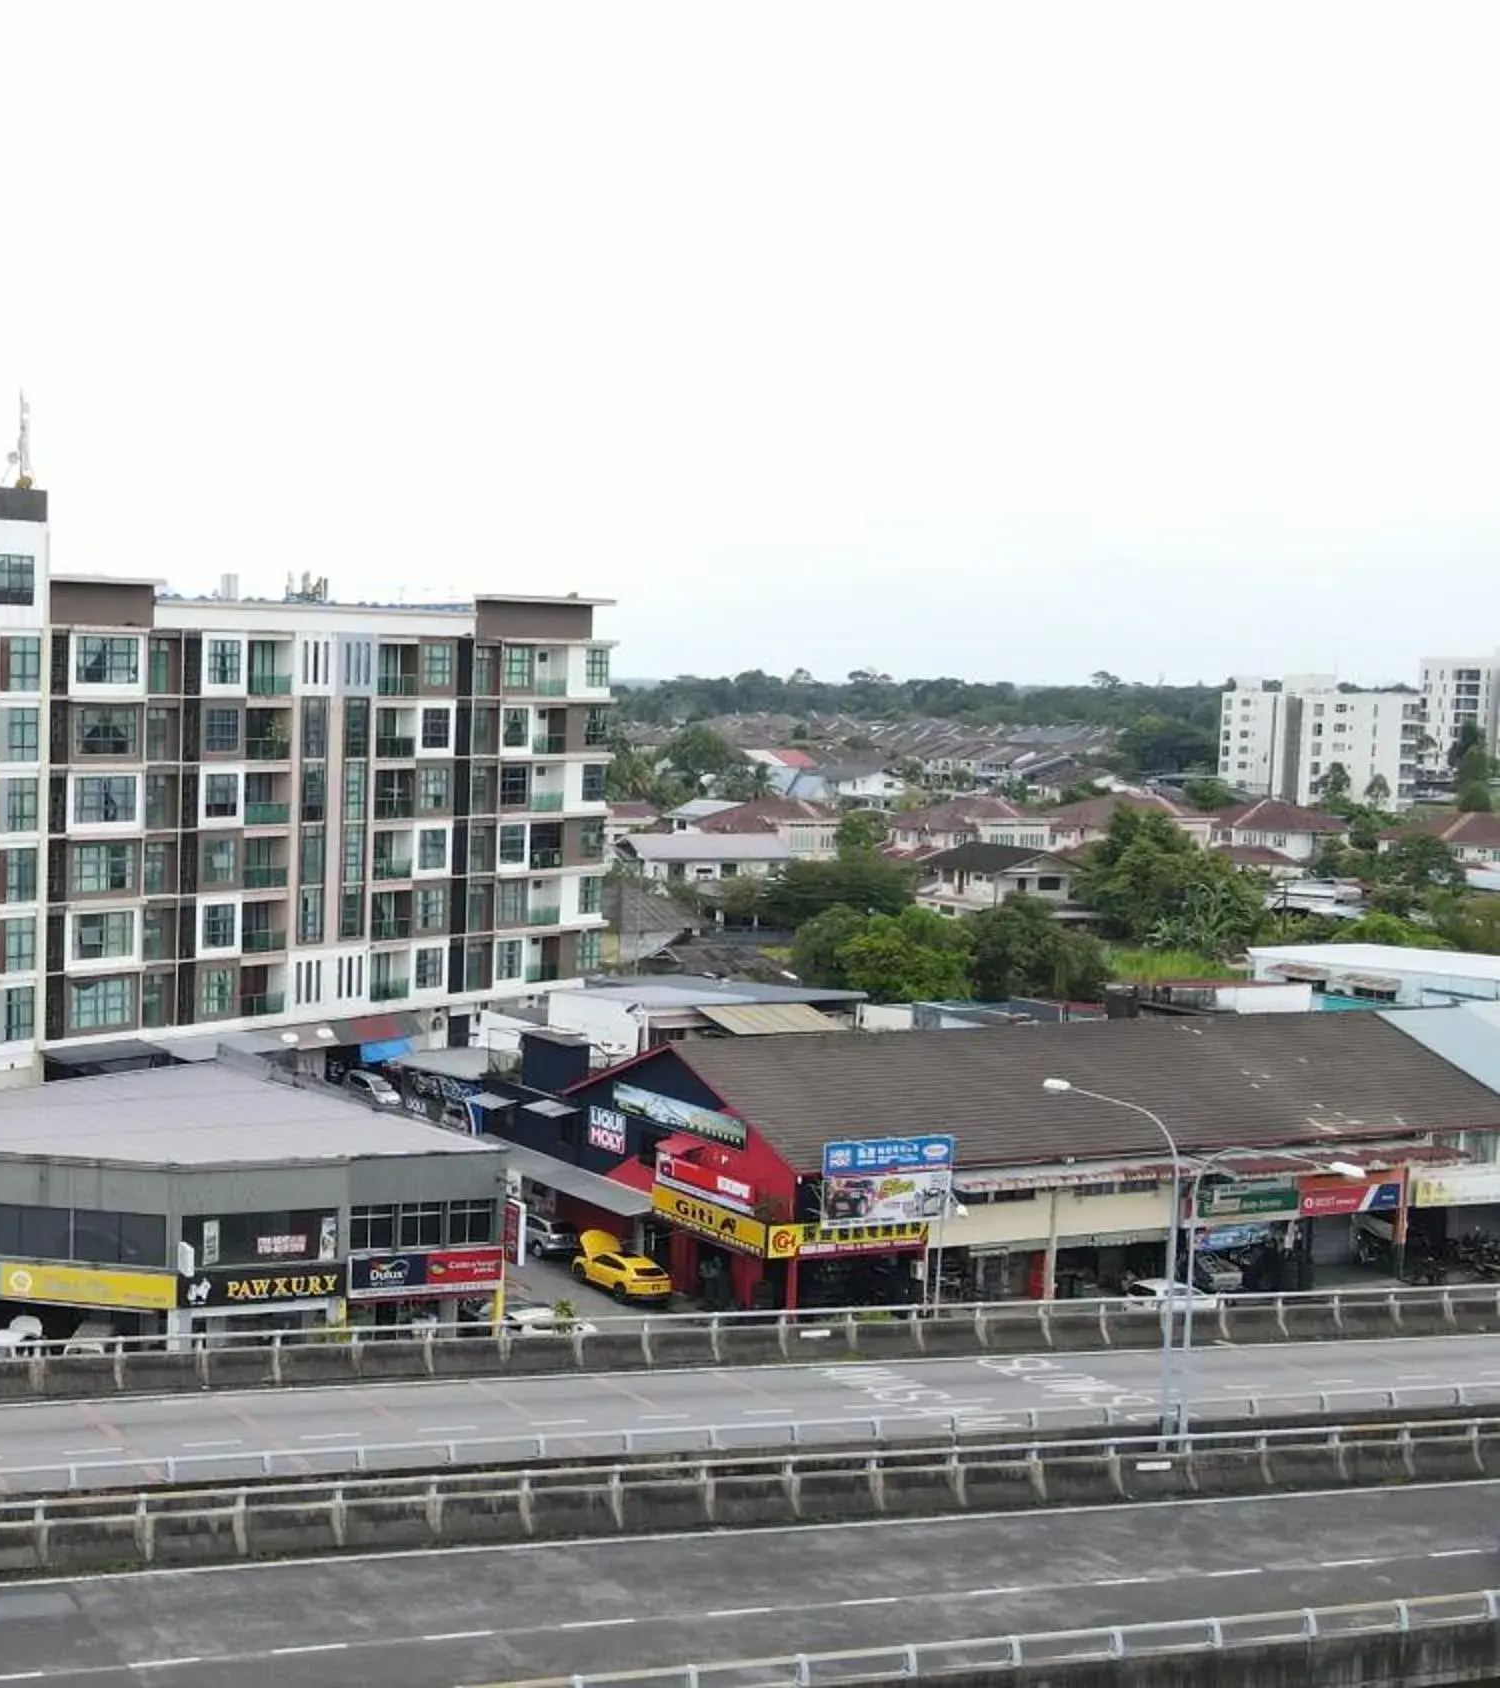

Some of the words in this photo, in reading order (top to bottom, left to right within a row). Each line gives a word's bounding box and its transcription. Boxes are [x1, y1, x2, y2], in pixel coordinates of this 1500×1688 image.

[590, 1105, 626, 1132] LIQUI
[675, 1199, 713, 1225] Giti
[227, 1274, 338, 1299] PAWXURY
